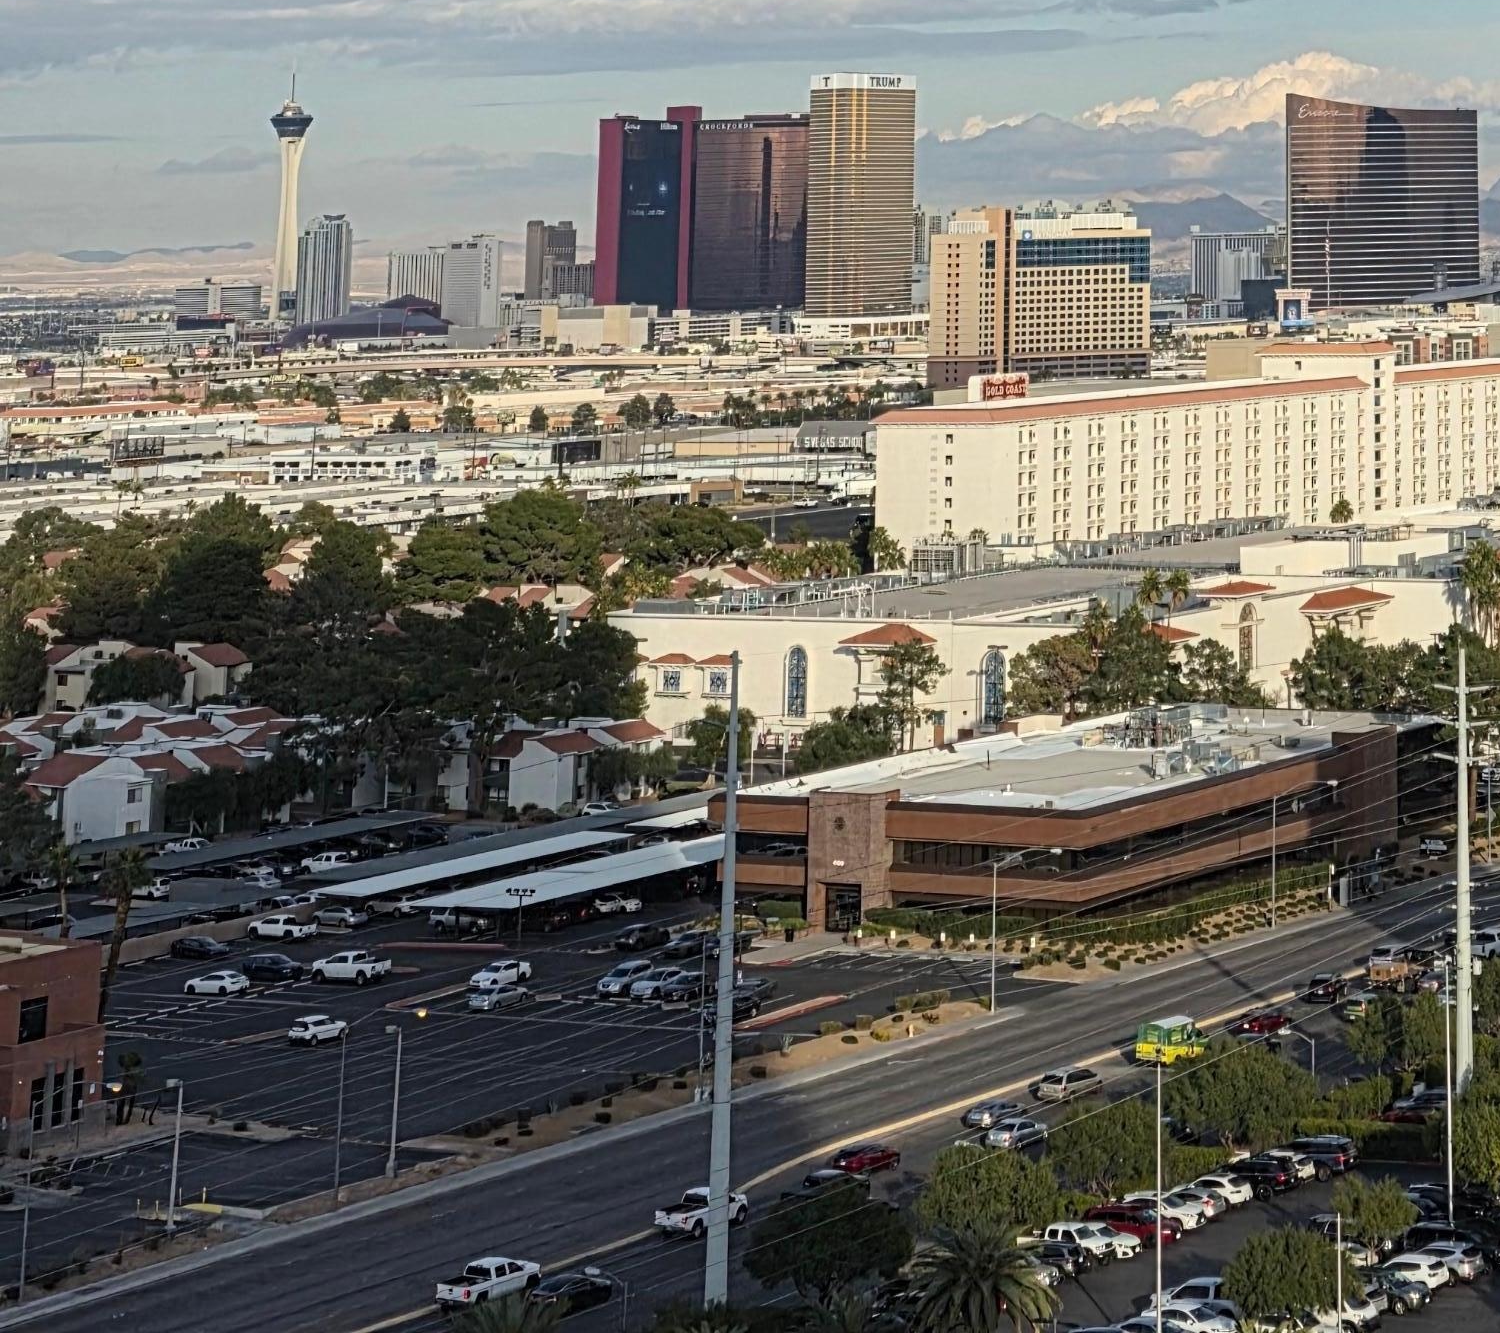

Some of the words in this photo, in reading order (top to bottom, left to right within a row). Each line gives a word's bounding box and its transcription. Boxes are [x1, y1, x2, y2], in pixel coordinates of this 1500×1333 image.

[869, 77, 901, 87] TRUMP
[700, 123, 754, 131] CROCKFORDS
[986, 385, 1004, 396] GOLD
[1005, 383, 1026, 394] COAST
